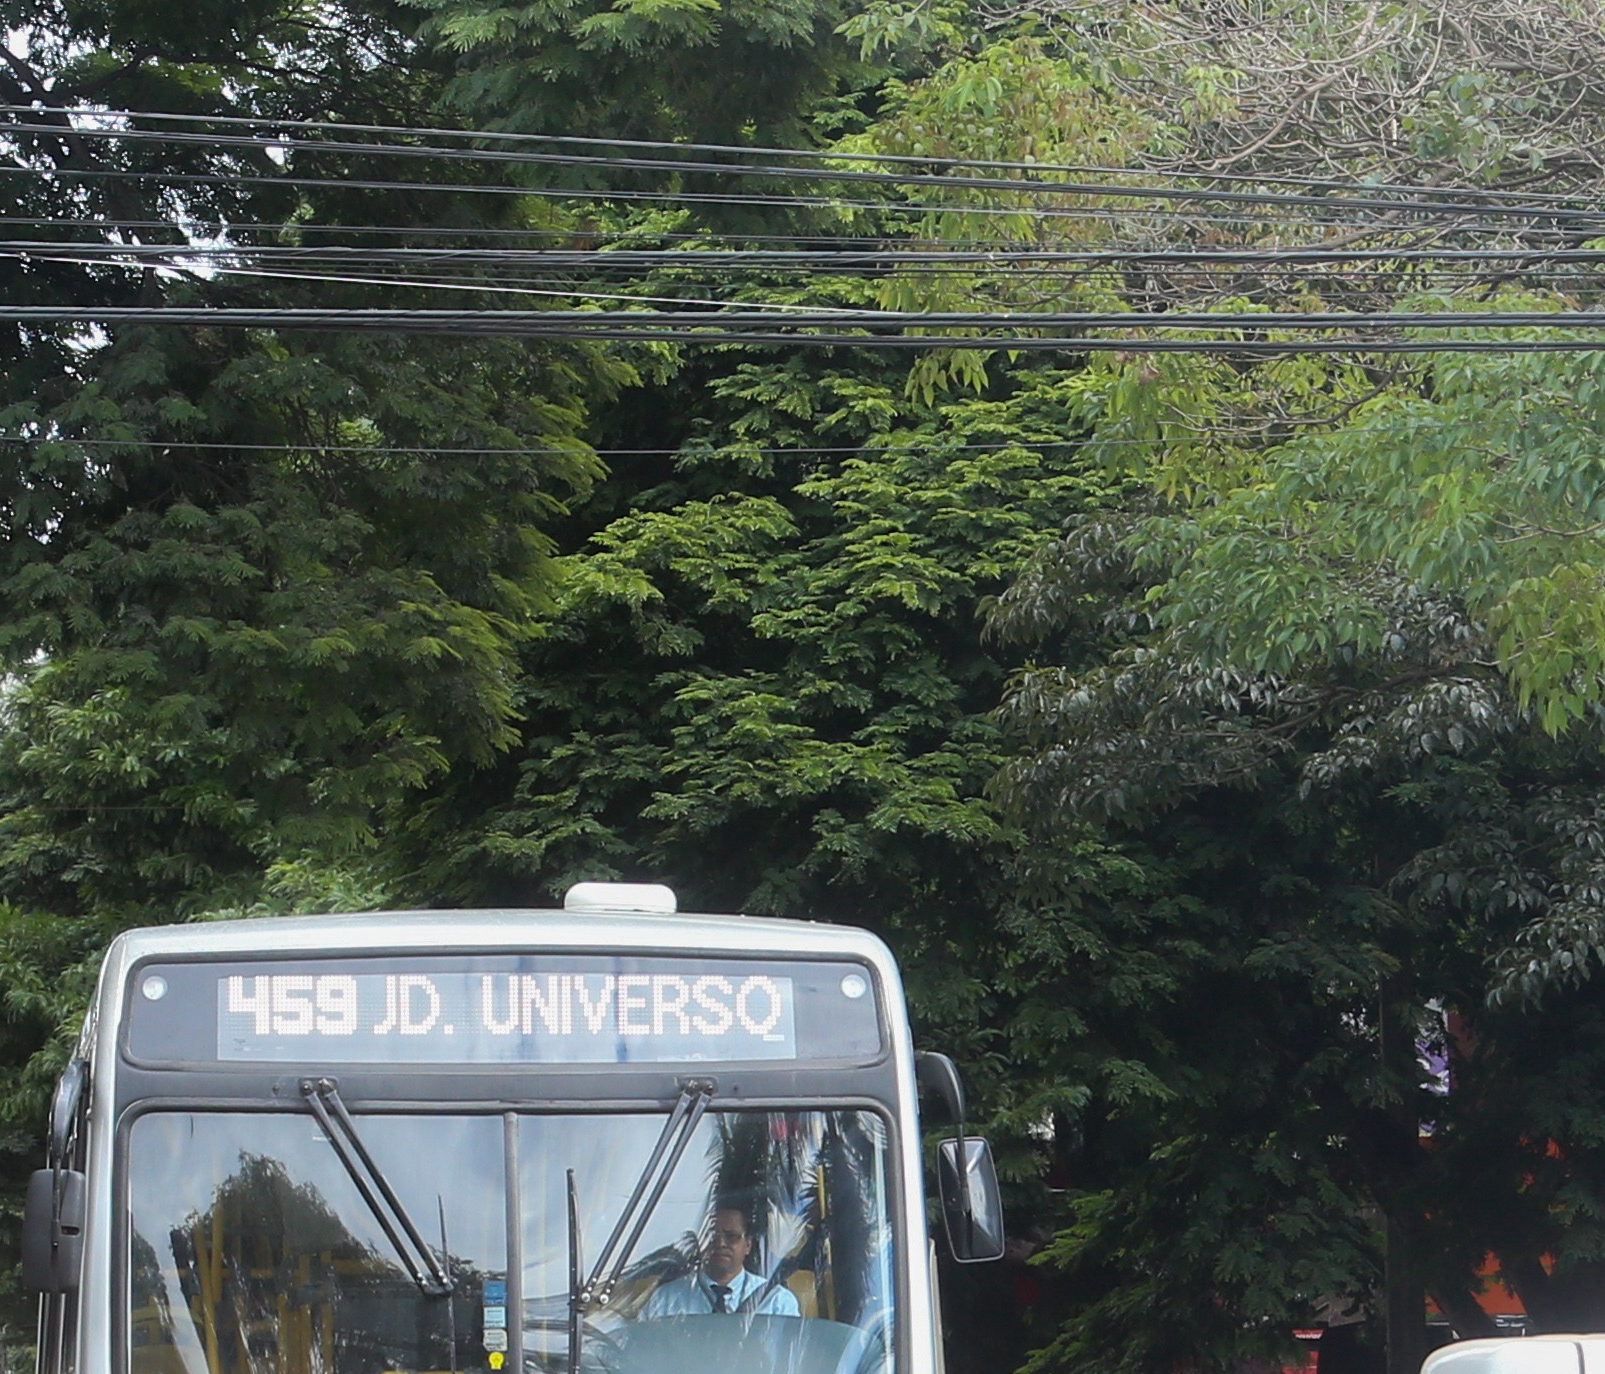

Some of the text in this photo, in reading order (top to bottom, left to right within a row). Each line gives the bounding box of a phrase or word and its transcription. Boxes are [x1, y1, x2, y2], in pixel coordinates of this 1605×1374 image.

[227, 975, 782, 1036] 459 JD. UNIVERSO
